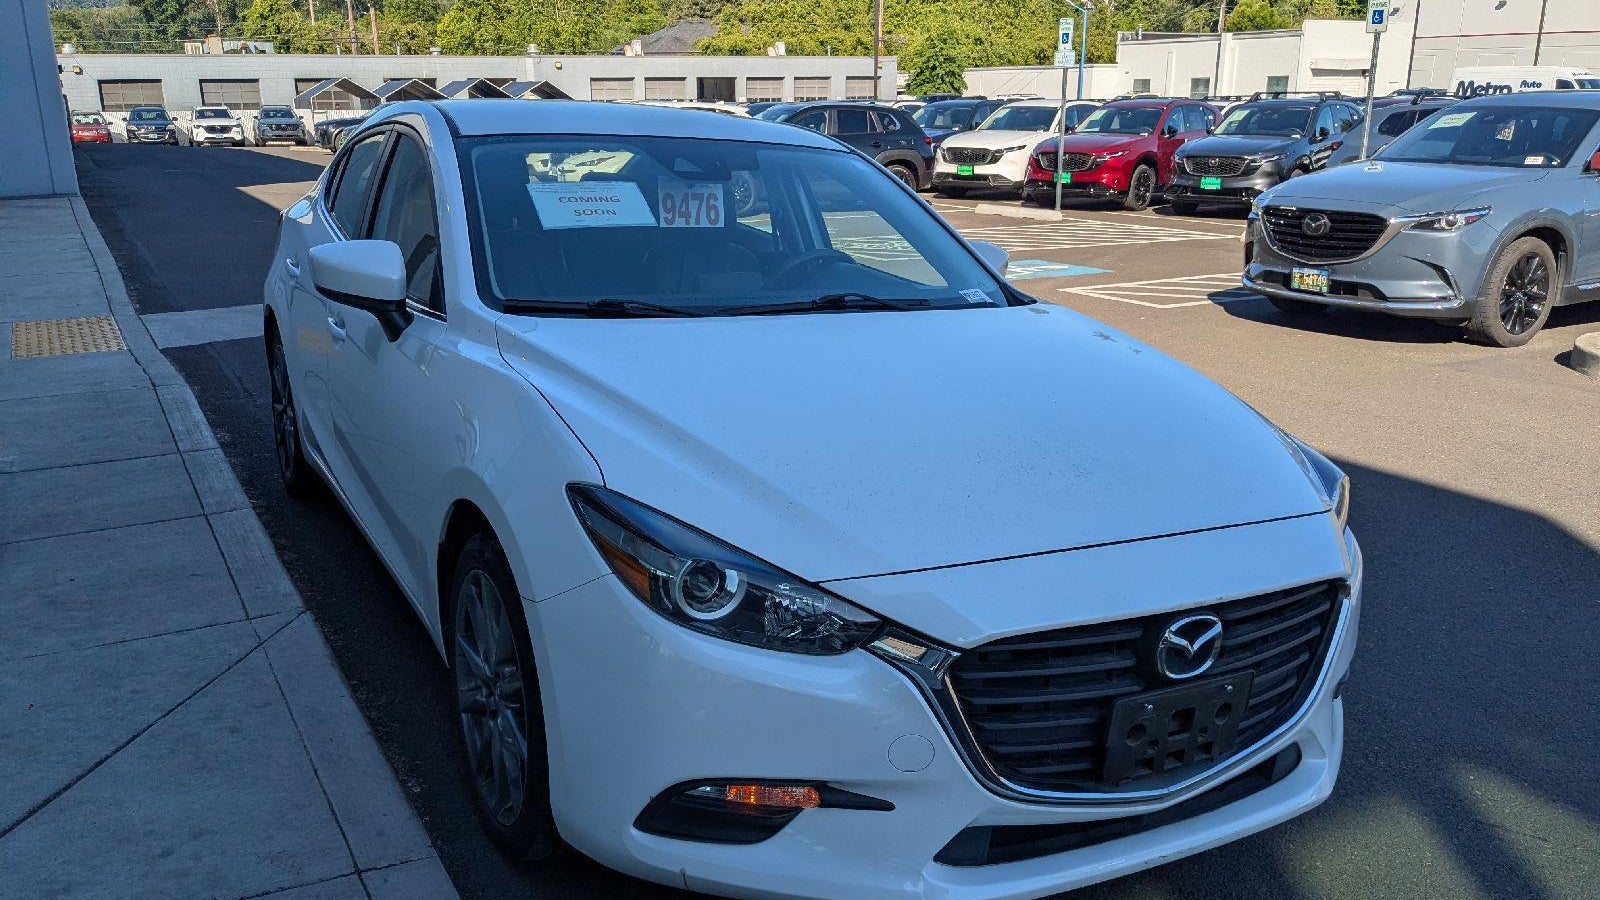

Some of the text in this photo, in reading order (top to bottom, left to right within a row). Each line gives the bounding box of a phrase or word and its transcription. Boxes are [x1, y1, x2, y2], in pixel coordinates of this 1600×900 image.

[1455, 80, 1543, 97] Metro Auto
[558, 195, 621, 204] COMING
[574, 208, 616, 217] SOON
[661, 192, 721, 226] 9476
